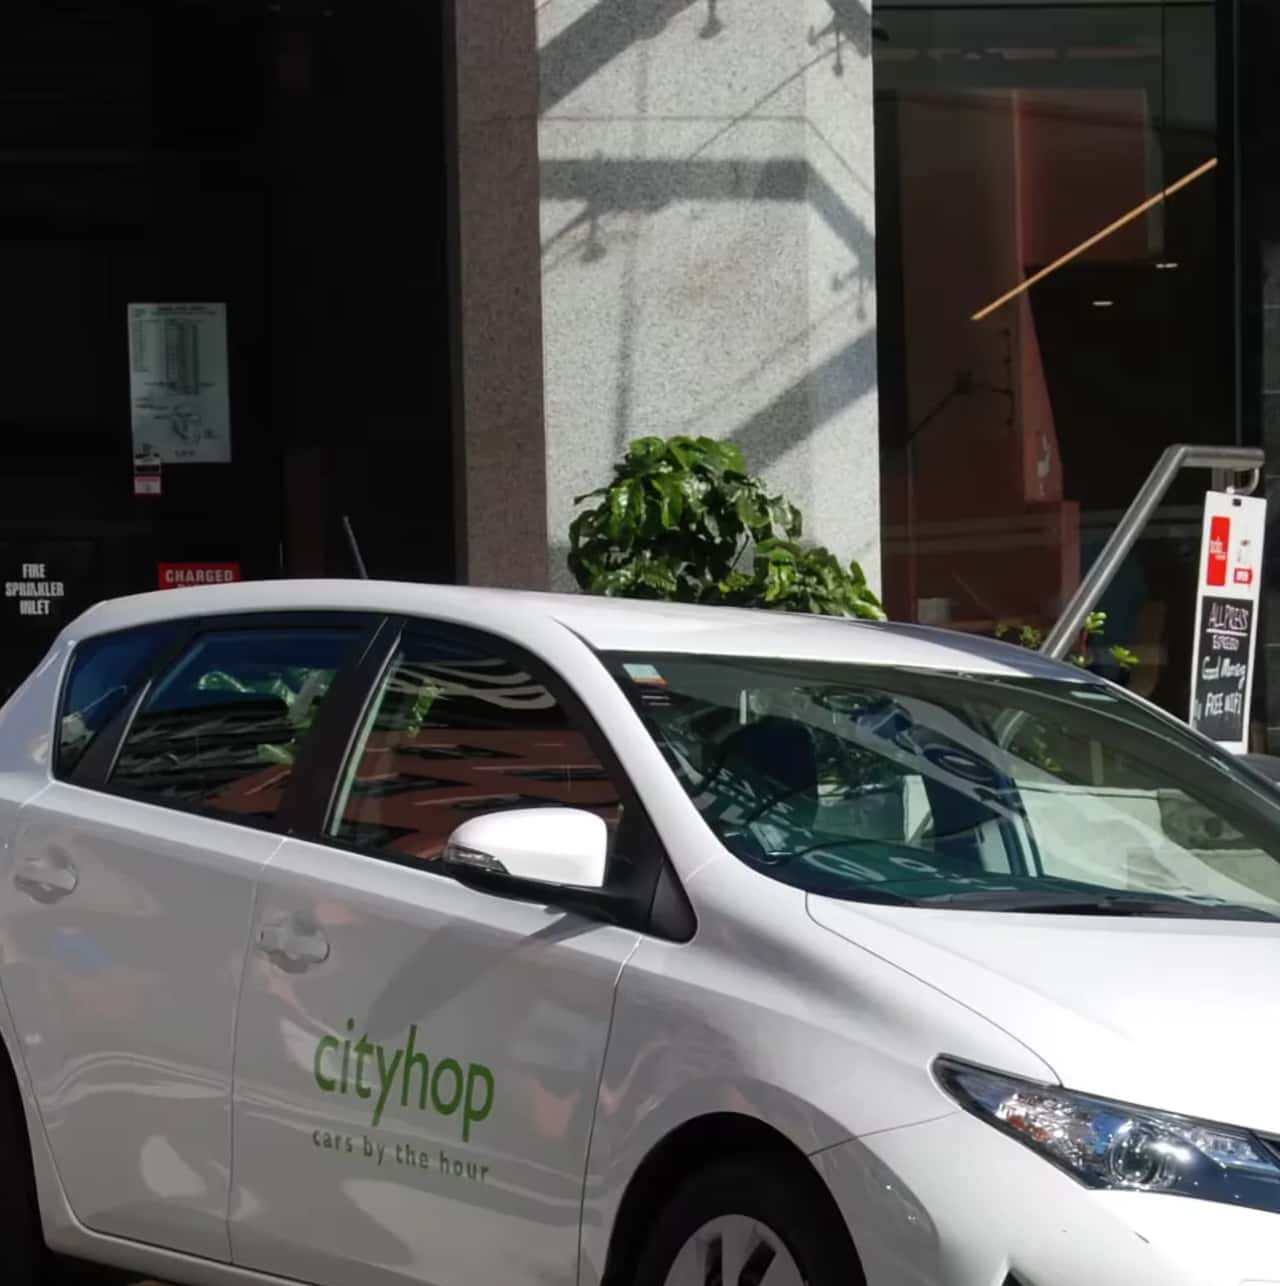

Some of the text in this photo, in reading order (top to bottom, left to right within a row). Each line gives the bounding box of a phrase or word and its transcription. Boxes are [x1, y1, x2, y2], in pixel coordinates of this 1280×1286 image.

[22, 562, 46, 579] FIRE
[165, 568, 234, 584] CHARGED
[4, 581, 65, 598] SPRINKLER
[19, 599, 51, 615] INLET
[313, 1017, 495, 1143] cityhop
[312, 1129, 490, 1182] cars by the hour
